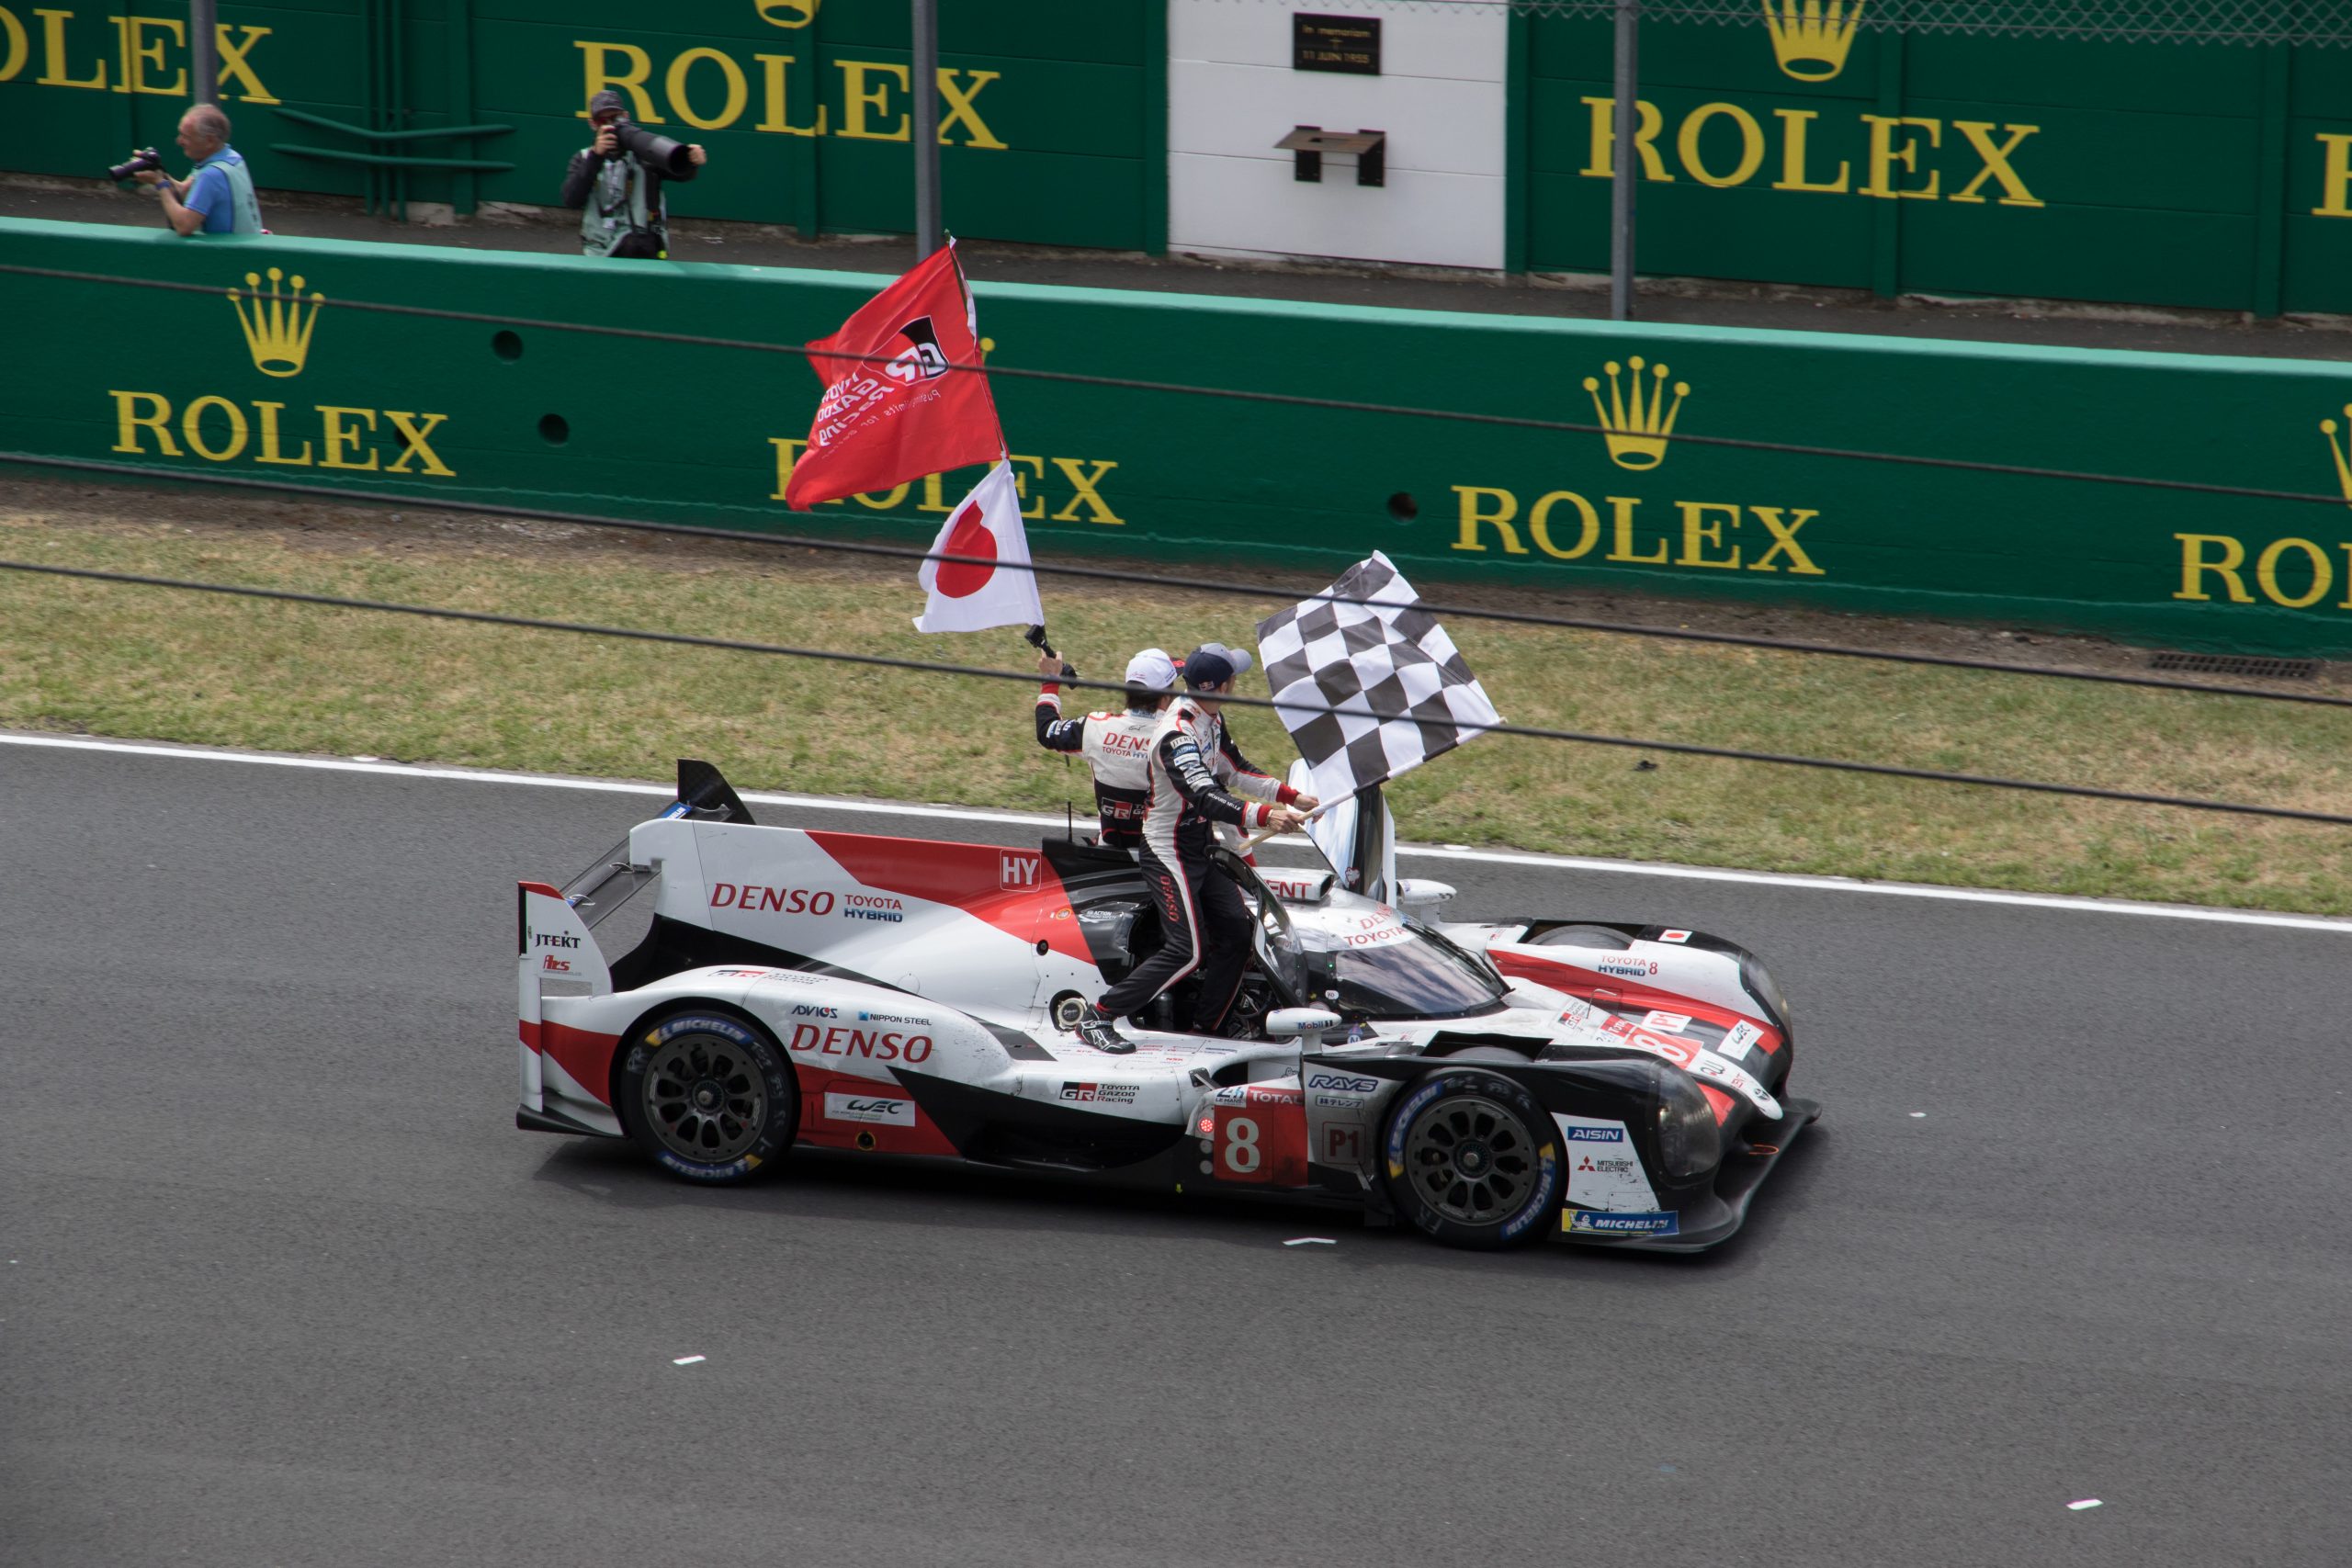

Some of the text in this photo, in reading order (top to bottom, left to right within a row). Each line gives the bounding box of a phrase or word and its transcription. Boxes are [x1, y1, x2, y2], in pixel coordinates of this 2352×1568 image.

[573, 40, 1009, 151] ROLEX
[1580, 96, 2046, 209] ROLEX
[108, 390, 457, 477] ROLEX
[1451, 485, 1826, 575] ROLEX
[2173, 533, 2352, 610] RO
[1102, 746, 1131, 757] TOYOTA
[1002, 856, 1039, 886] HY
[711, 883, 903, 916] DENSO TOYOTA
[844, 908, 903, 923] HYBRID
[535, 933, 581, 949] JTEKT
[1344, 925, 1408, 947] TOYOTA
[1598, 962, 1657, 976] HYBRID 8
[1601, 955, 1646, 967] TOYOTA
[869, 1013, 933, 1026] NIPPON STEEL
[1298, 1021, 1324, 1030] Mobil
[1650, 1014, 1685, 1028] P1
[669, 1020, 747, 1042] MICHELIN
[790, 1023, 933, 1064] DENSO
[1633, 1033, 1689, 1062] 8
[1061, 1083, 1140, 1101] GR TOYOTA
[1309, 1075, 1378, 1093] RAYS
[847, 1099, 904, 1115] WEC
[1097, 1096, 1134, 1105] Racing
[1329, 1129, 1359, 1158] P1
[1572, 1129, 1620, 1140] AISIN
[1225, 1117, 1261, 1174] 8
[1595, 1218, 1669, 1230] MICHELIN
